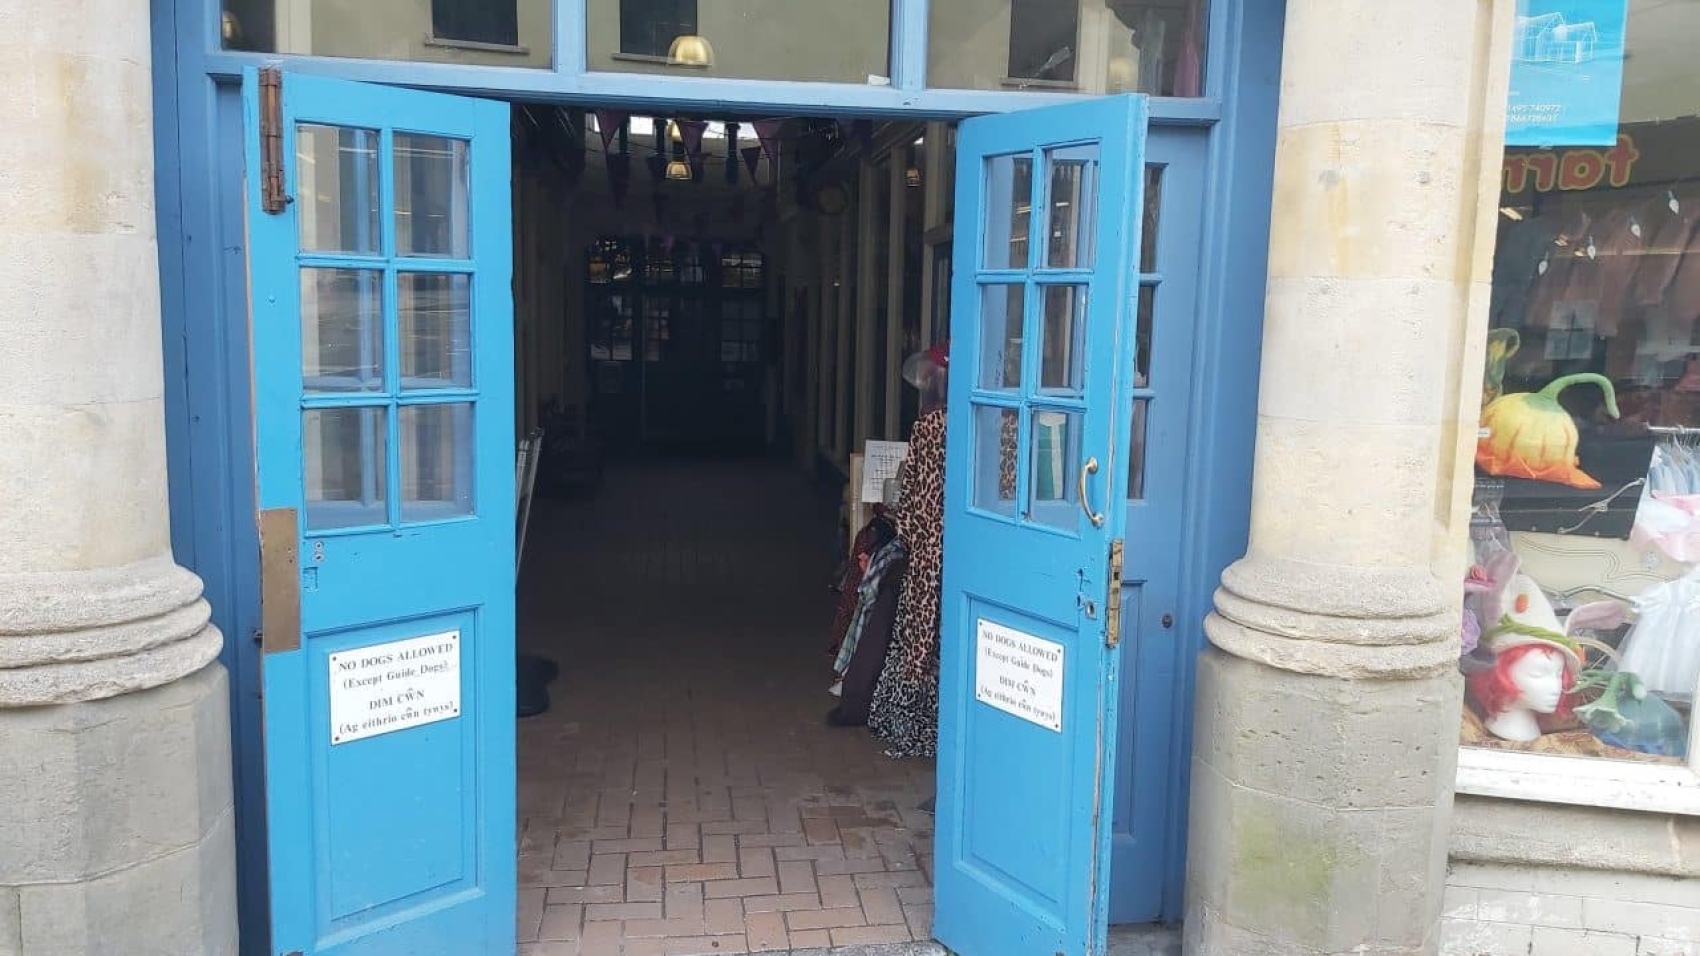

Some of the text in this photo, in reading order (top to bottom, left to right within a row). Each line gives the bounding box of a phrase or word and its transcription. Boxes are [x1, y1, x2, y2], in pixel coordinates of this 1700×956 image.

[339, 643, 453, 671] NO DOGS ALLOWED
[982, 630, 1058, 662] NO DOGS ALLOWED
[343, 674, 382, 690] (Except
[387, 668, 416, 681] Guide
[369, 697, 393, 710] DIM
[339, 722, 358, 735] (Ag
[362, 713, 397, 730] eithrio
